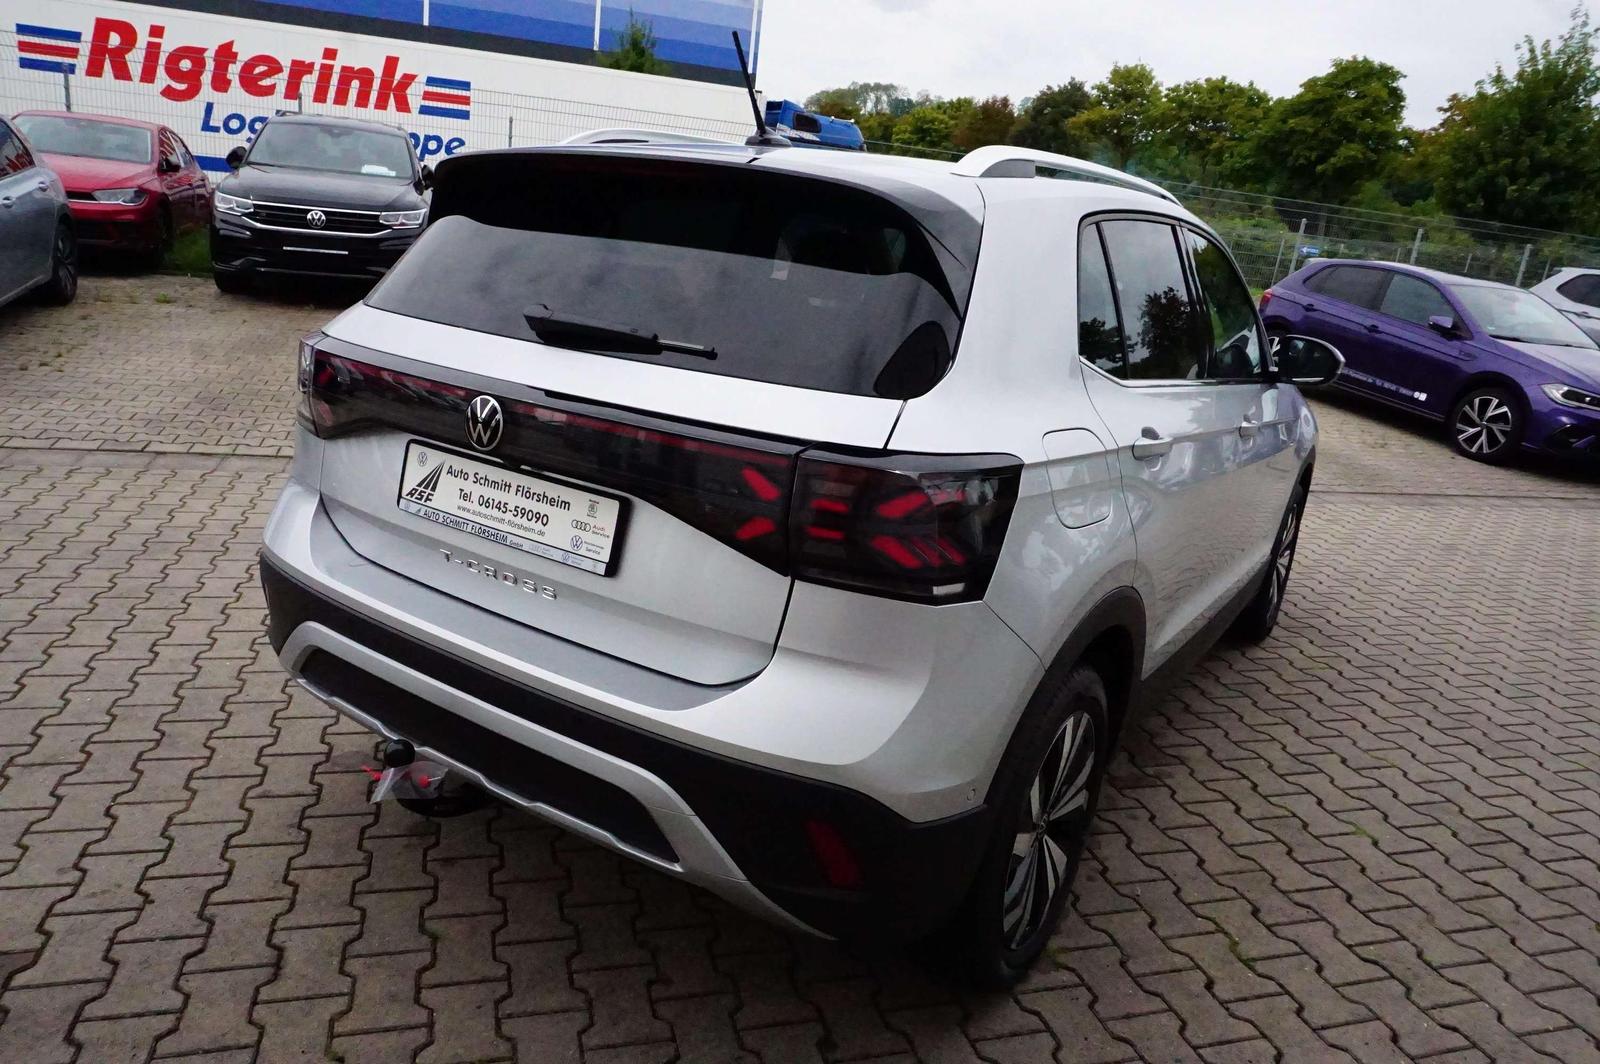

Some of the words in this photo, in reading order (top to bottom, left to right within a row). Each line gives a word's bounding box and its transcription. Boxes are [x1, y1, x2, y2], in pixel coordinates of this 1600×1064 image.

[85, 17, 419, 114] Rigterink
[405, 487, 435, 503] ASF
[446, 465, 470, 481] Auto
[472, 472, 512, 494] Schmitt
[514, 484, 572, 512] Flörsheim
[458, 488, 475, 504] Tel.
[477, 494, 550, 528] 06145-59090
[423, 509, 440, 521] AUTO
[441, 516, 470, 533] SCHMITT
[440, 549, 557, 600] T-CROSS
